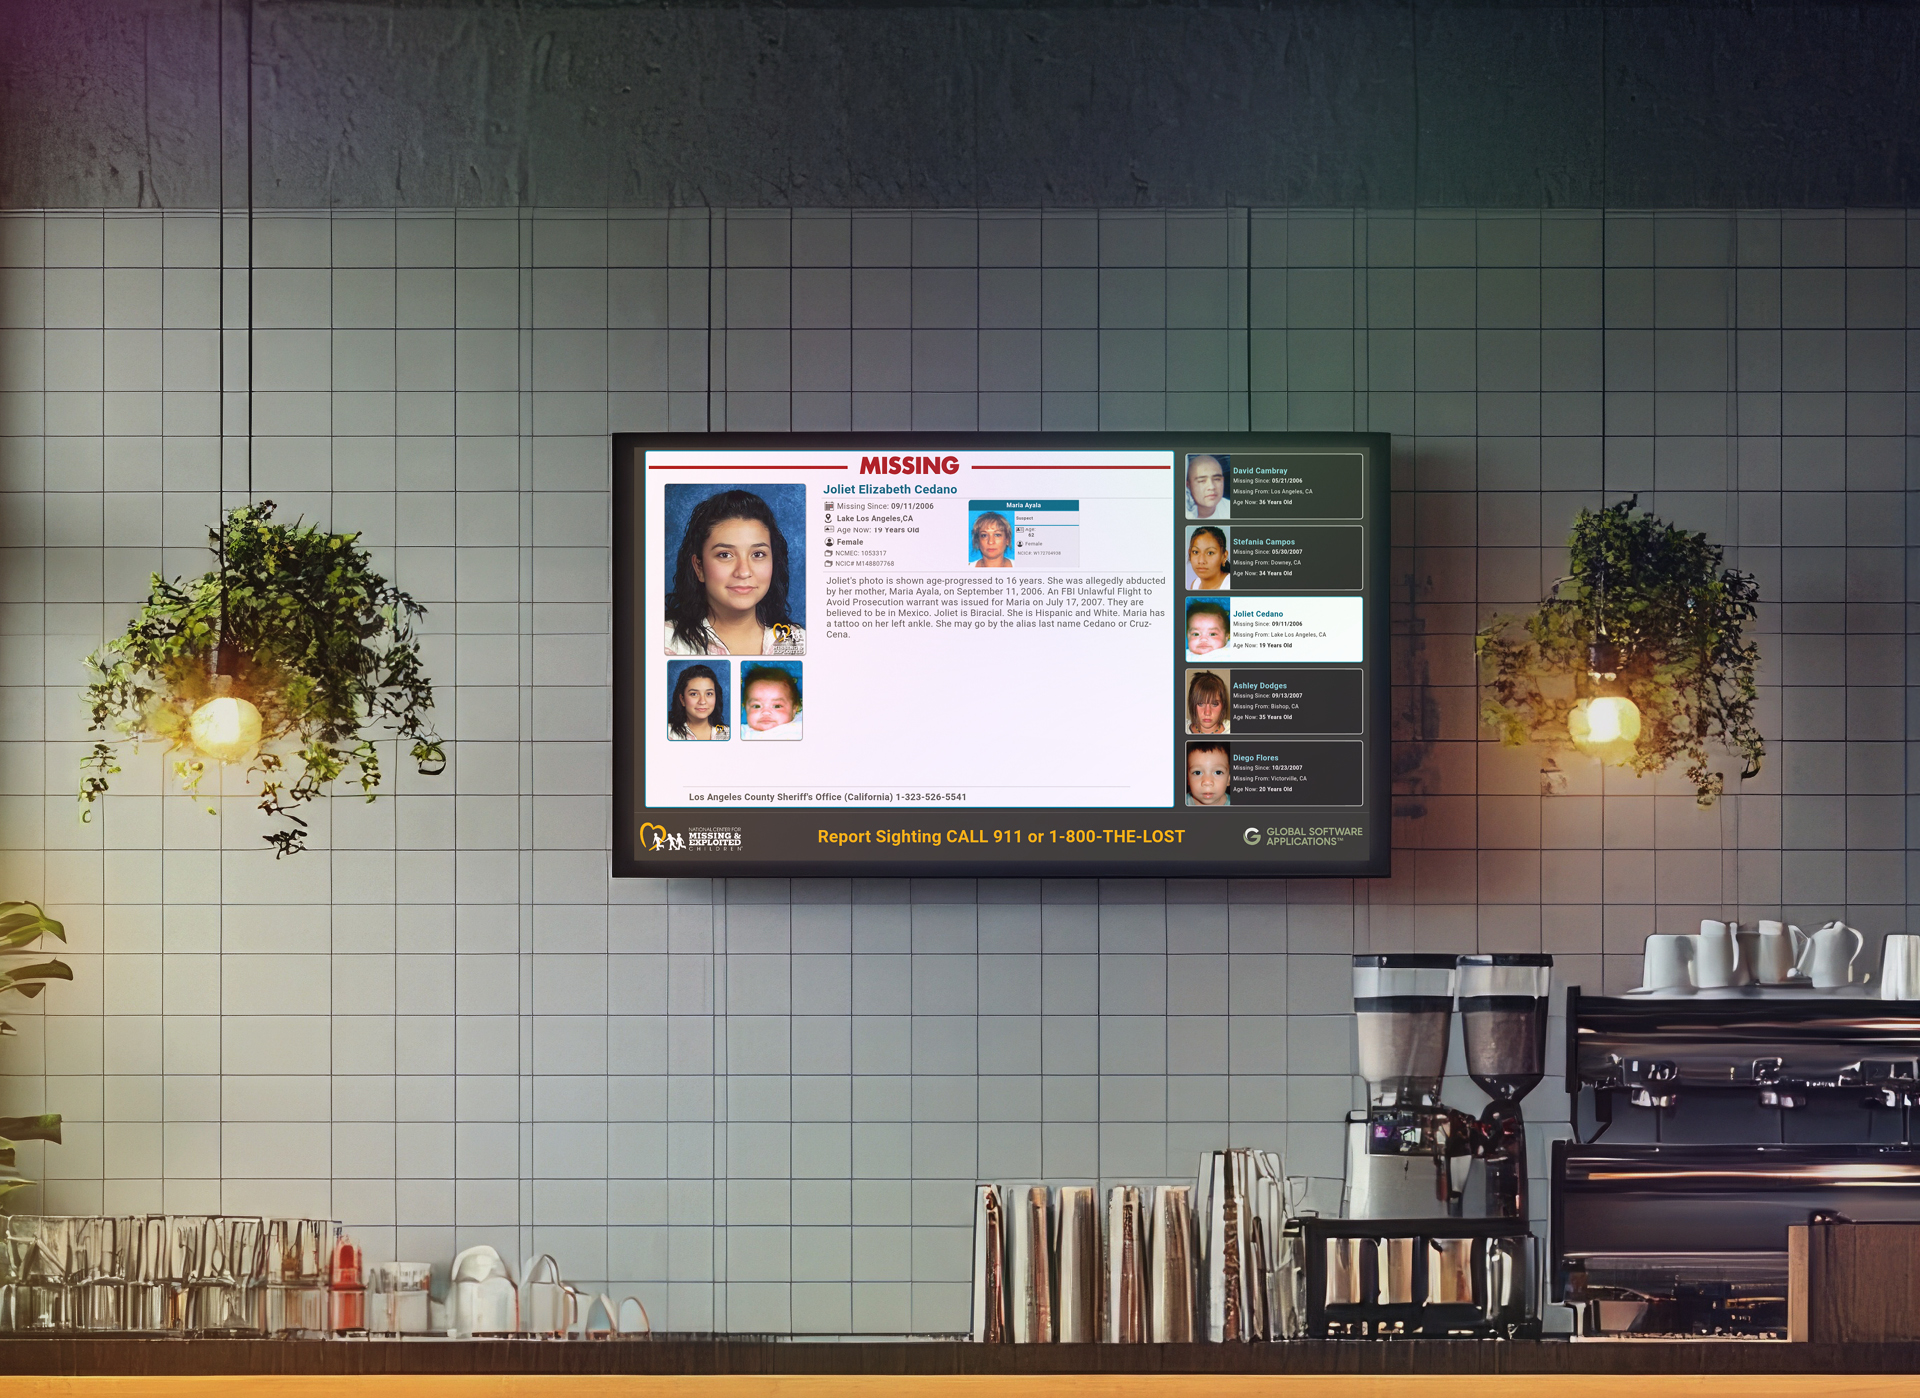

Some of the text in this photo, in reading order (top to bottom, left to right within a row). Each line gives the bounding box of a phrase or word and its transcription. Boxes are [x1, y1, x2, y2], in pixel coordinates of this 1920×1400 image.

[859, 456, 960, 475] MISSING
[1255, 467, 1288, 475] Cambray
[823, 484, 957, 494] Joliet Elizabeth Cedano
[837, 503, 865, 511] Missing
[1265, 538, 1295, 547] Campos
[826, 576, 857, 584] Joliet's
[859, 576, 884, 586] photo
[896, 577, 924, 585] shown
[926, 576, 993, 586] age-progressed
[1019, 578, 1045, 586] years.
[1085, 576, 1124, 586] allegedly
[1126, 576, 1166, 584] abducted
[826, 587, 836, 597] by
[839, 587, 852, 595] her
[855, 587, 887, 596] mother,
[916, 587, 941, 597] Ayala,
[957, 587, 1003, 597] September
[1006, 588, 1018, 596] 11,
[1078, 587, 1115, 595] Unlawful
[1117, 587, 1141, 597] Flight
[826, 598, 850, 606] Avoid
[853, 598, 904, 606] Prosecution
[961, 598, 989, 606] issued
[991, 598, 1004, 606] for
[1046, 598, 1064, 608] July
[1066, 598, 1079, 607] 17,
[1081, 598, 1105, 606] 2007.
[1107, 598, 1128, 608] They
[1035, 609, 1073, 618] Hispanic
[875, 619, 889, 627] her
[891, 619, 905, 627] left
[908, 619, 933, 627] ankle.
[936, 619, 952, 627] She
[954, 621, 972, 629] may
[974, 621, 986, 629] go
[988, 620, 998, 629] by
[1000, 619, 1014, 627] the
[1016, 619, 1036, 627] alias
[1083, 619, 1116, 627] Cedano
[1233, 682, 1287, 690] Ashley Dodges
[707, 793, 742, 803] Angeles
[744, 793, 775, 803] County
[777, 793, 813, 801] Sheriff's
[815, 793, 842, 801] Office
[844, 793, 893, 802] (California)
[1267, 827, 1363, 836] GLOBAL SOFTWARE
[818, 829, 1185, 846] Report Sighting CALL 911 or 1-800-THE-LOST
